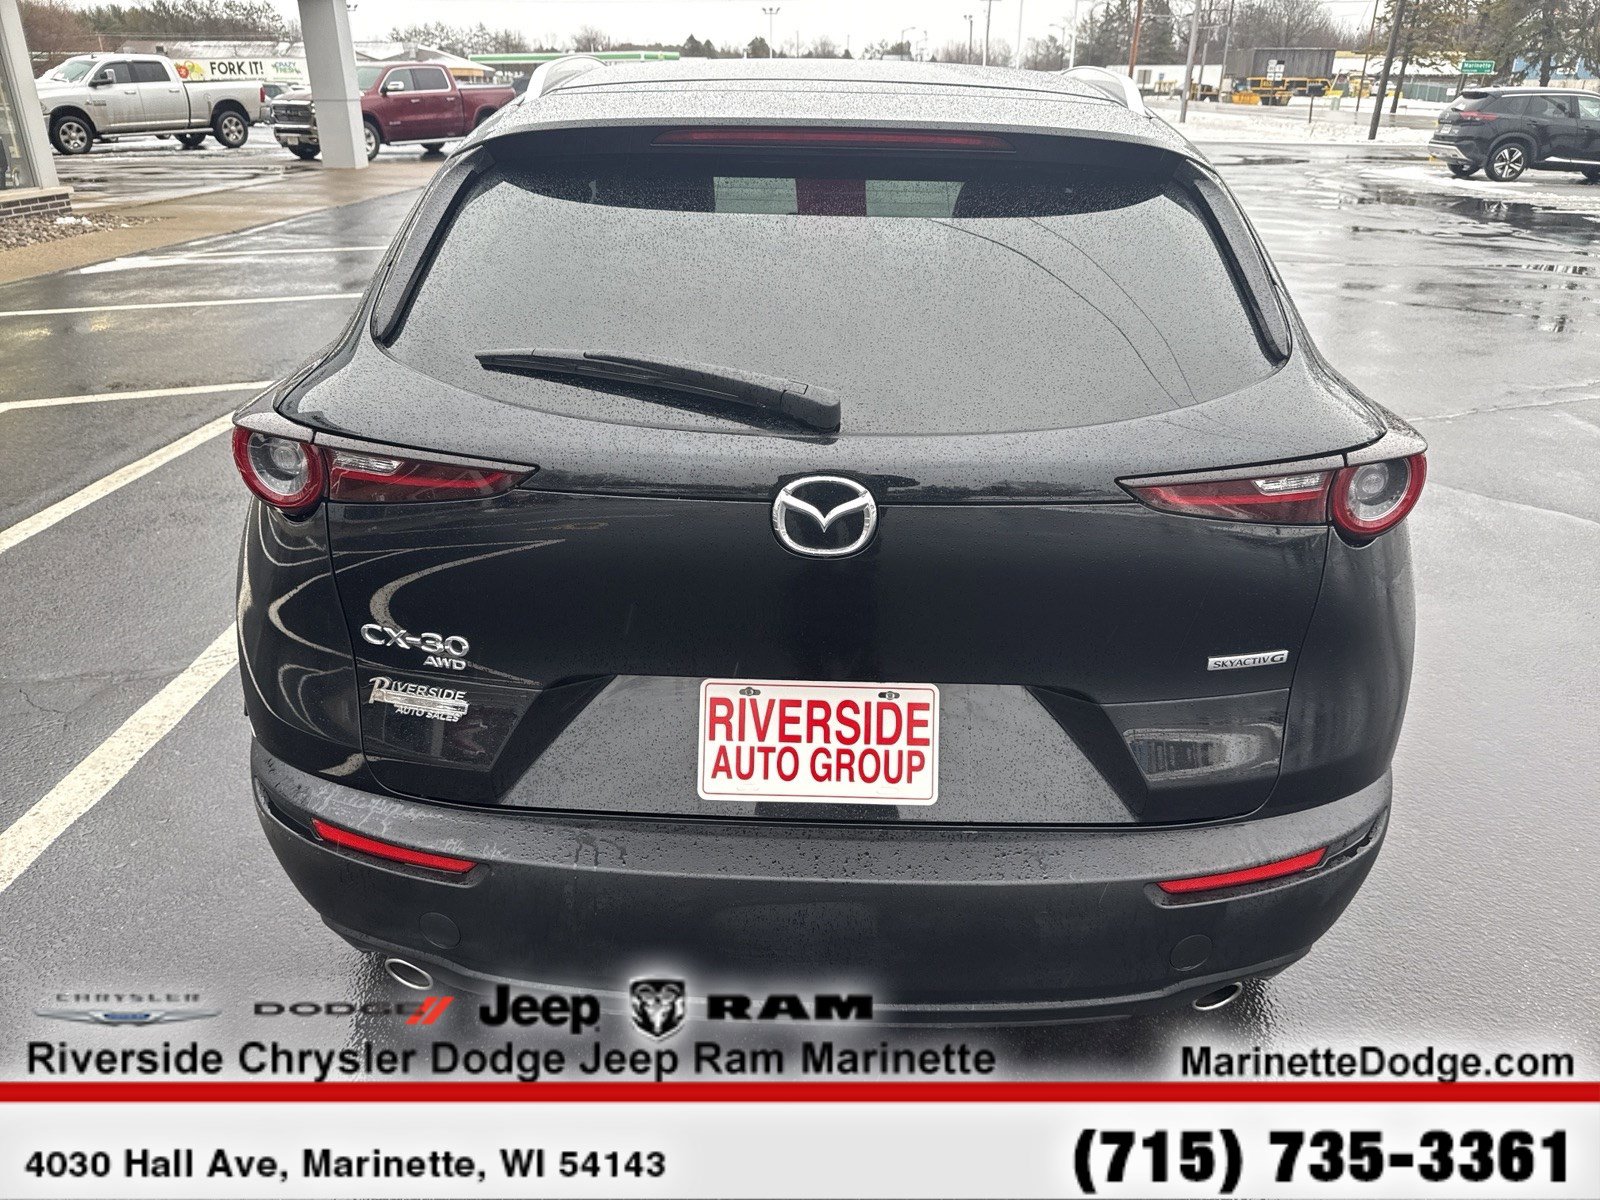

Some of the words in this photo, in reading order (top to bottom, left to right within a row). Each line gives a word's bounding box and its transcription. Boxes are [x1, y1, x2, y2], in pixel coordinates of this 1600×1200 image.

[209, 61, 247, 75] FORK
[249, 61, 264, 74] IT!
[360, 623, 470, 657] CX-30
[423, 655, 467, 671] AWD
[368, 676, 466, 704] RIVERSIDE
[395, 706, 425, 717] AUTO
[426, 709, 461, 723] SALES
[708, 697, 930, 746] RIVERSIDE
[711, 745, 799, 781] AUTO
[809, 747, 925, 784] GROUP
